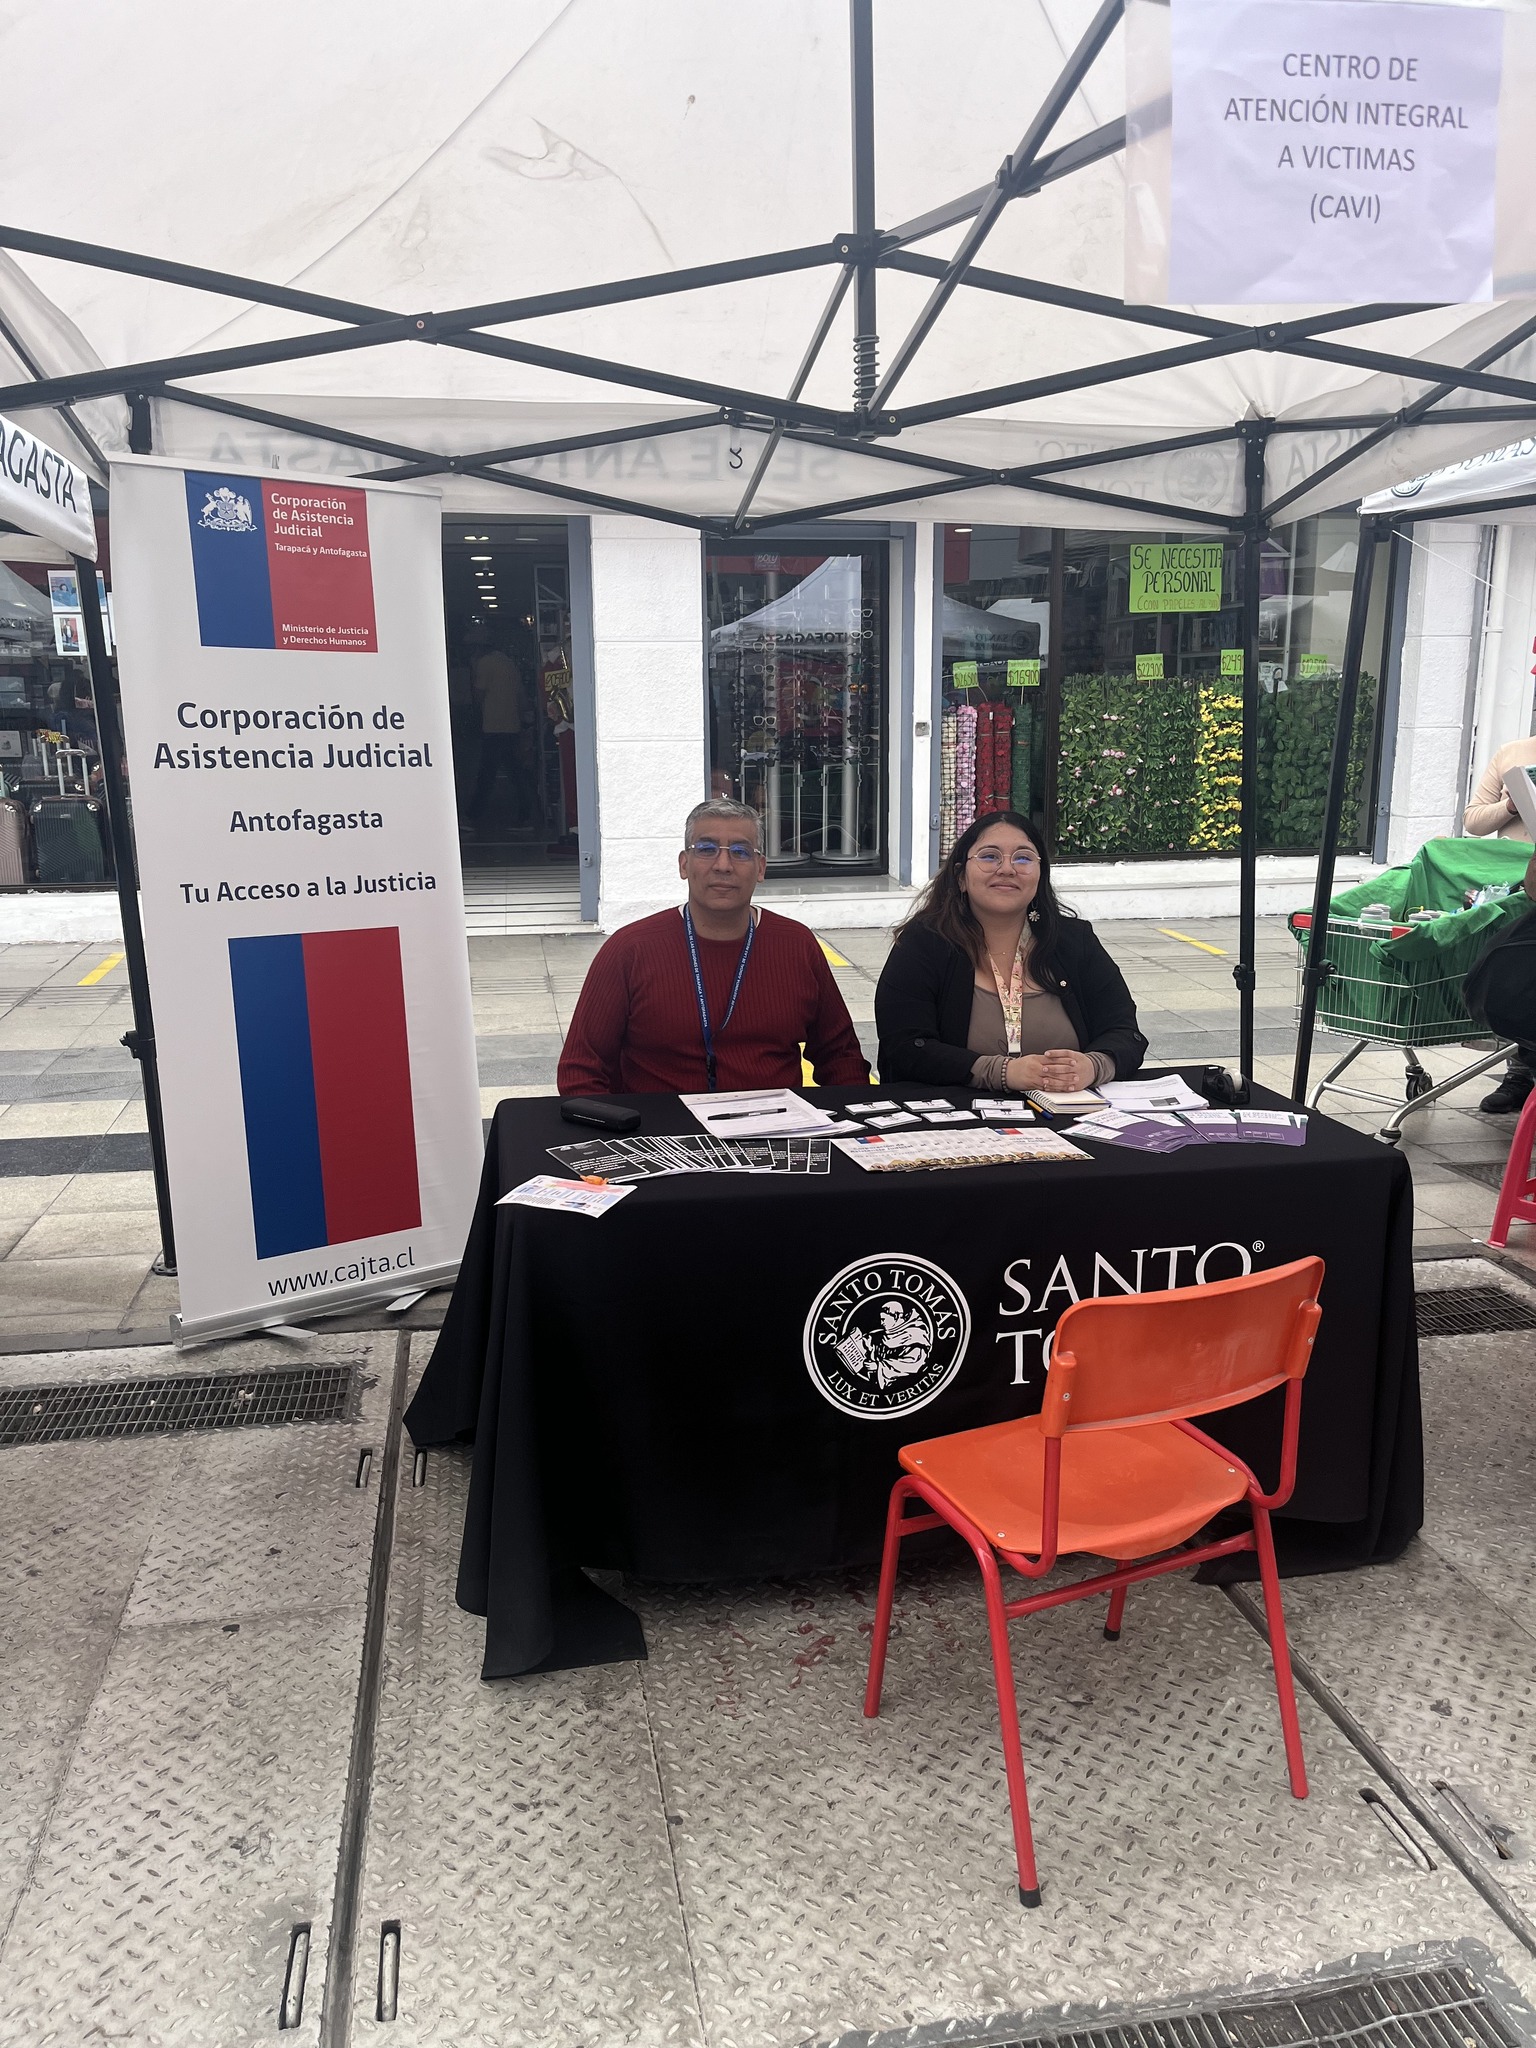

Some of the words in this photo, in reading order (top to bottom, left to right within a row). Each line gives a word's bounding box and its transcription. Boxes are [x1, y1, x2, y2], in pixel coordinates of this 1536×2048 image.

[1282, 52, 1381, 80] CENTRO
[1388, 57, 1419, 82] DE
[1223, 94, 1349, 124] ATENCIÓN
[1355, 101, 1470, 130] INTEGRAL
[1277, 145, 1295, 168] A
[1302, 145, 1416, 172] VICTIMAS
[1309, 192, 1381, 224] (CAVI)
[270, 492, 347, 511] Corporación
[272, 509, 288, 520] de
[291, 510, 354, 526] Asistencia
[274, 523, 323, 538] Judicial
[274, 542, 312, 555] Tarapacá
[312, 546, 318, 555] y
[319, 546, 368, 559] Antofagasta
[1132, 545, 1152, 570] SE
[1160, 547, 1223, 570] NECESITA
[1141, 570, 1216, 594] PERSONAL
[282, 623, 324, 634] Ministerio
[326, 625, 336, 635] de
[337, 626, 369, 636] Justicia
[283, 636, 289, 645] y
[290, 634, 328, 645] Derechos
[329, 637, 367, 646] Humanos
[1007, 669, 1040, 687] $16900
[1136, 662, 1165, 679] $22900
[176, 701, 364, 736] Corporación
[371, 705, 406, 731] de
[153, 742, 314, 770] Asistencia
[322, 742, 433, 770] Judicial
[229, 808, 384, 836] Antofagasta
[179, 882, 210, 904] Tu
[216, 880, 301, 903] Acceso
[306, 883, 320, 898] a
[325, 875, 347, 896] la
[353, 872, 437, 897] Justicia
[267, 1245, 416, 1298] www.cajta.cl
[817, 1271, 882, 1346] SANTO
[889, 1269, 959, 1340] TOMÁS
[826, 1369, 858, 1401] LUX
[857, 1391, 880, 1407] ET
